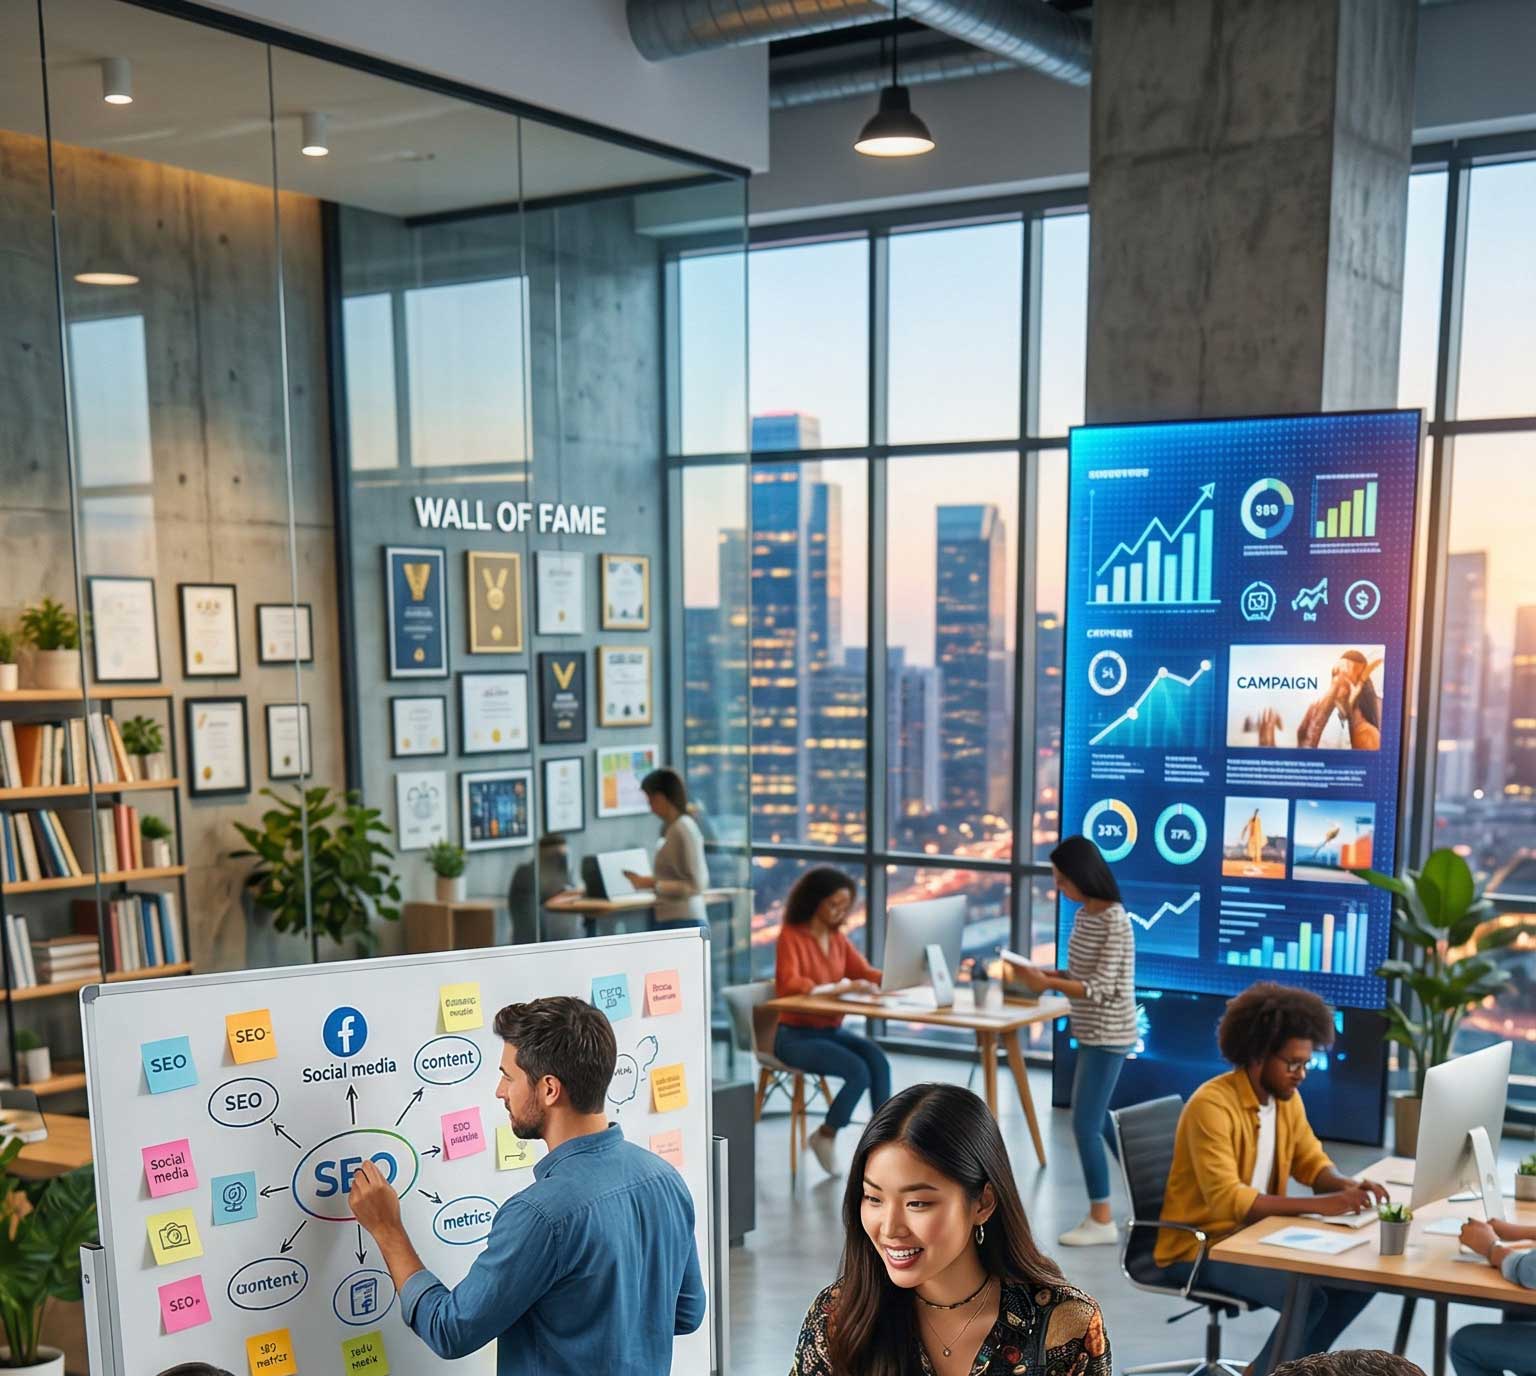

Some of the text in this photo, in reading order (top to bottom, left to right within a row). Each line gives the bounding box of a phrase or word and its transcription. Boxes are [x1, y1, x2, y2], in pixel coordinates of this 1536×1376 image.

[415, 496, 607, 535] WALL OF FAME
[1236, 676, 1318, 690] CAMPAIGN
[235, 1027, 266, 1043] SEO
[150, 1054, 187, 1073] SEO
[421, 1050, 474, 1070] content
[302, 1057, 397, 1083] Social media
[225, 1092, 262, 1111] SEO
[150, 1152, 186, 1170] Social
[154, 1167, 189, 1184] media
[443, 1209, 493, 1230] metrics
